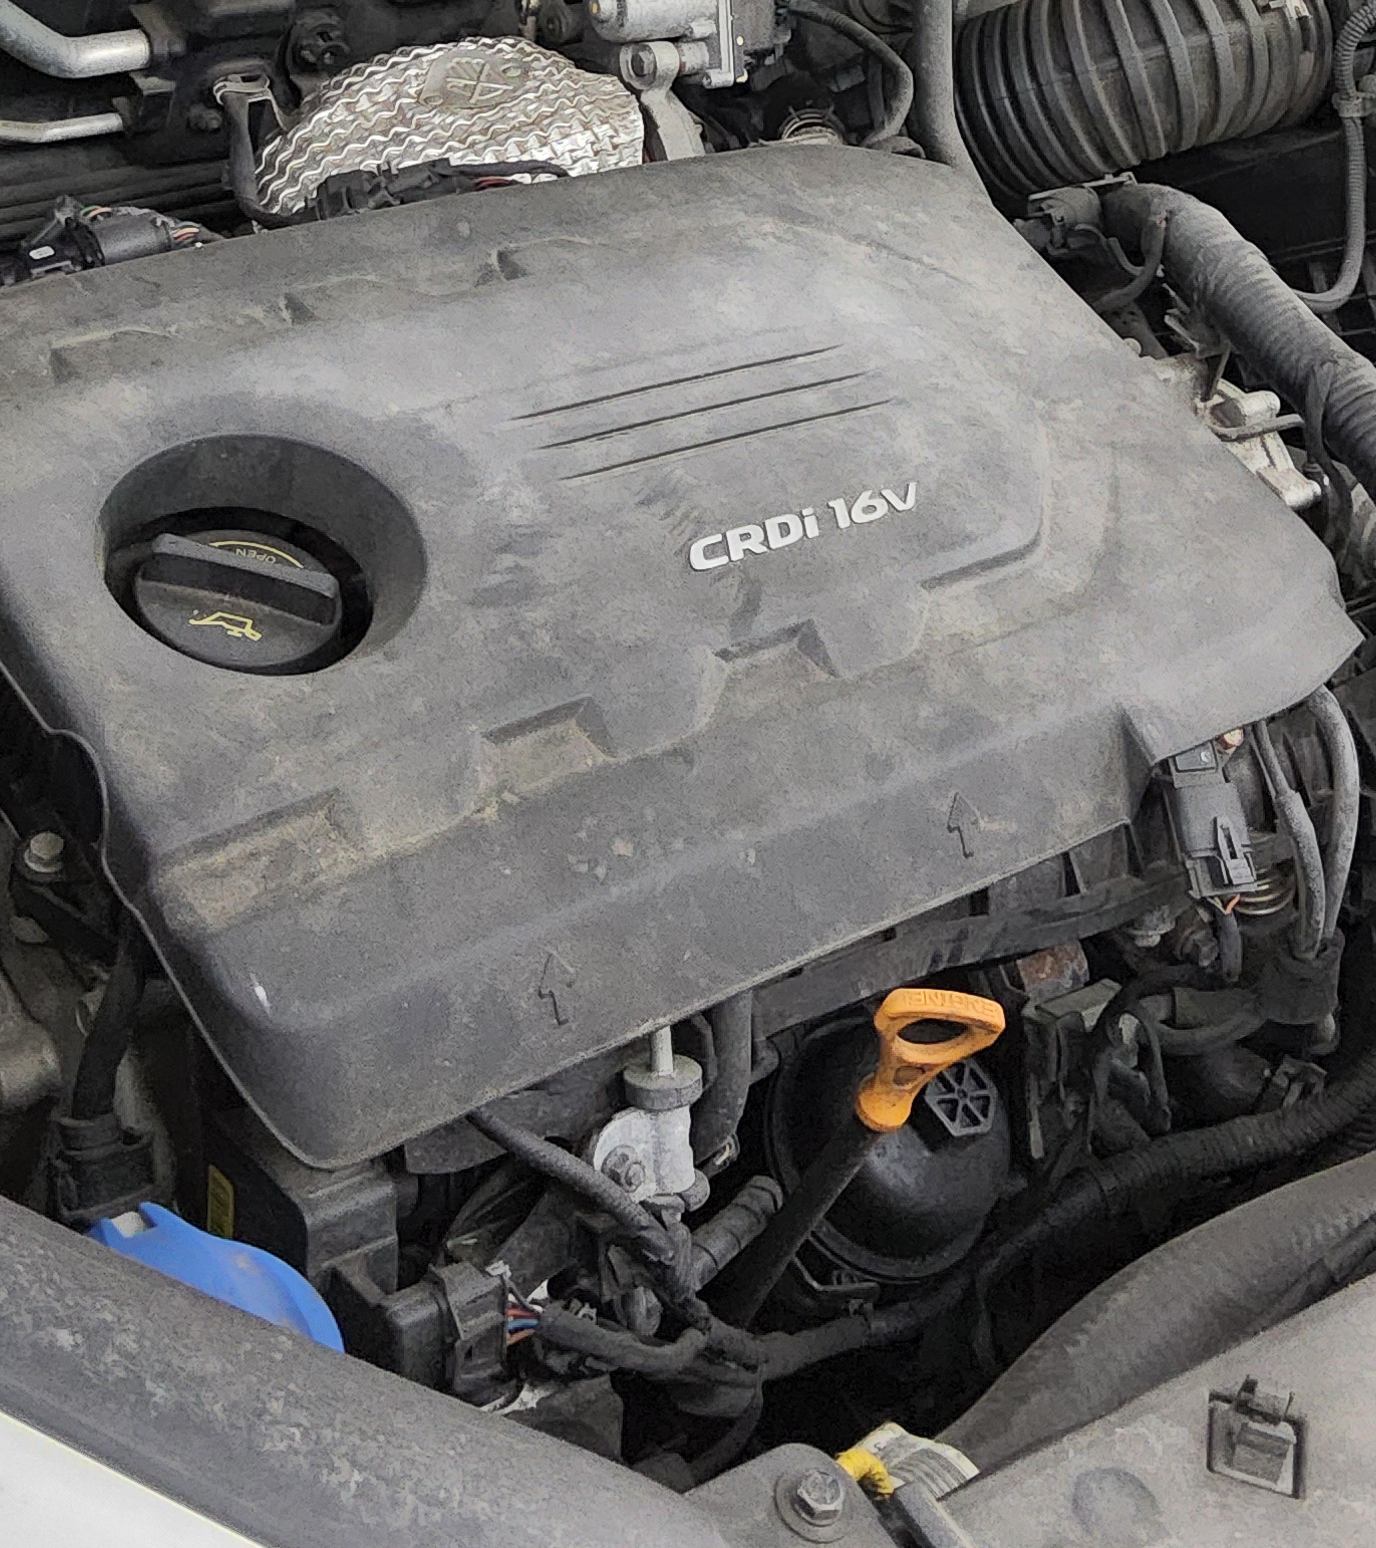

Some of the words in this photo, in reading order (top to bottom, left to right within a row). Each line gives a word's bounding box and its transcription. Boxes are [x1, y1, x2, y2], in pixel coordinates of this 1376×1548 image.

[688, 507, 820, 571] CRDi
[827, 481, 918, 529] 16V
[235, 548, 277, 564] OPEN
